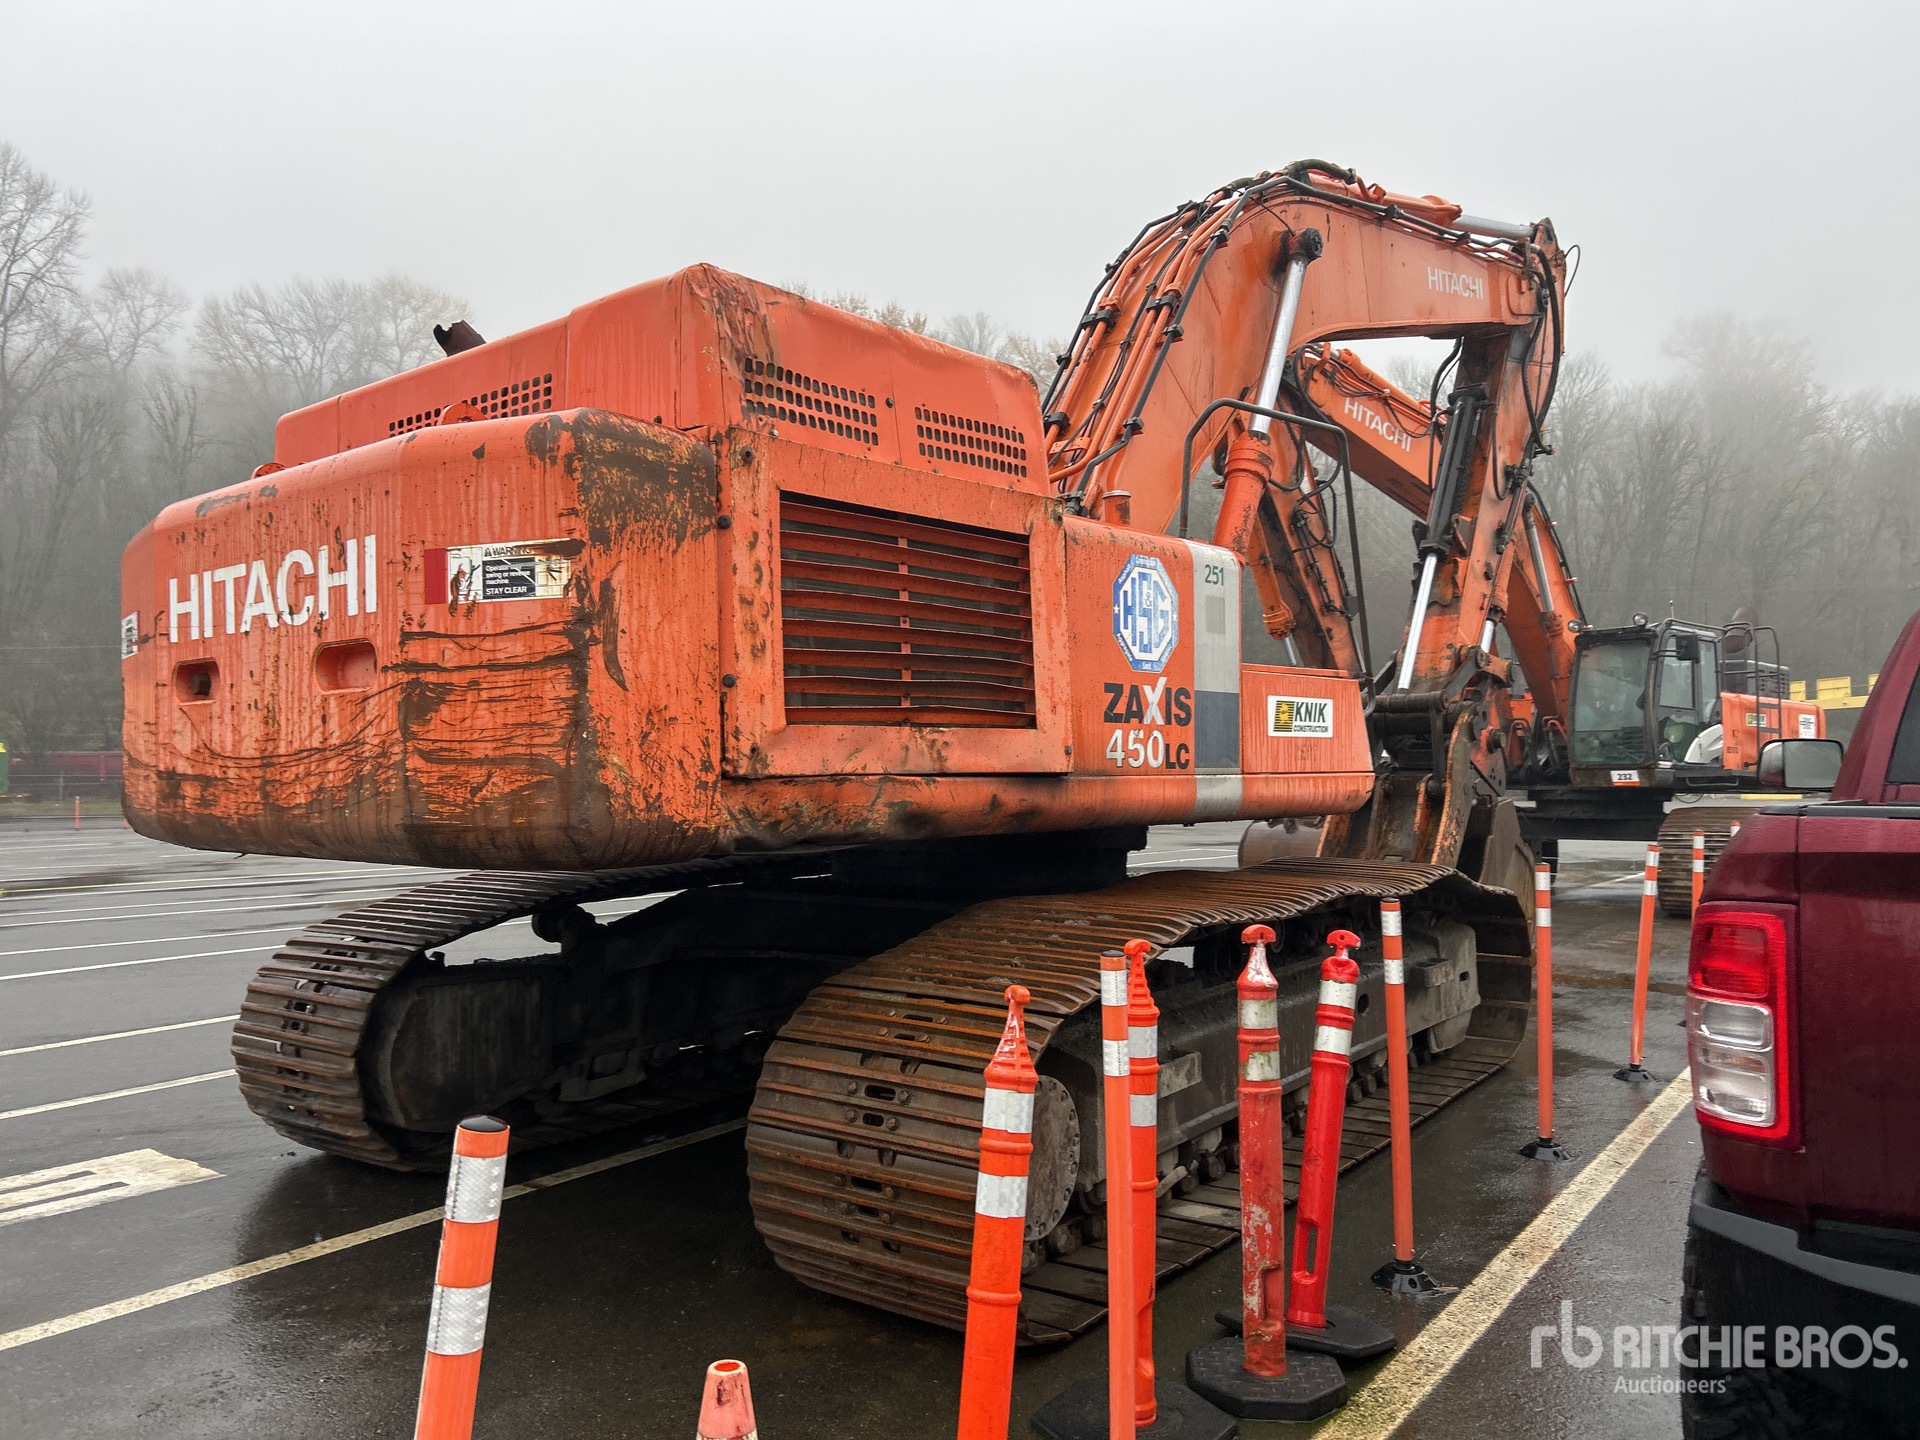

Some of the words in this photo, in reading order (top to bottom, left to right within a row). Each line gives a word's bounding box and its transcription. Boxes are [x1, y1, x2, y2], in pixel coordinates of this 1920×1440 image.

[1427, 266, 1483, 299] HITACHI
[1344, 396, 1411, 452] HITACHI
[493, 546, 531, 557] WARNING
[1204, 564, 1225, 587] 251
[168, 534, 377, 643] HITACHI
[504, 586, 527, 594] CLEAR
[1103, 677, 1192, 727] ZAXIS
[1294, 701, 1328, 723] KNIK
[1293, 724, 1329, 733] CONSTRUCTION
